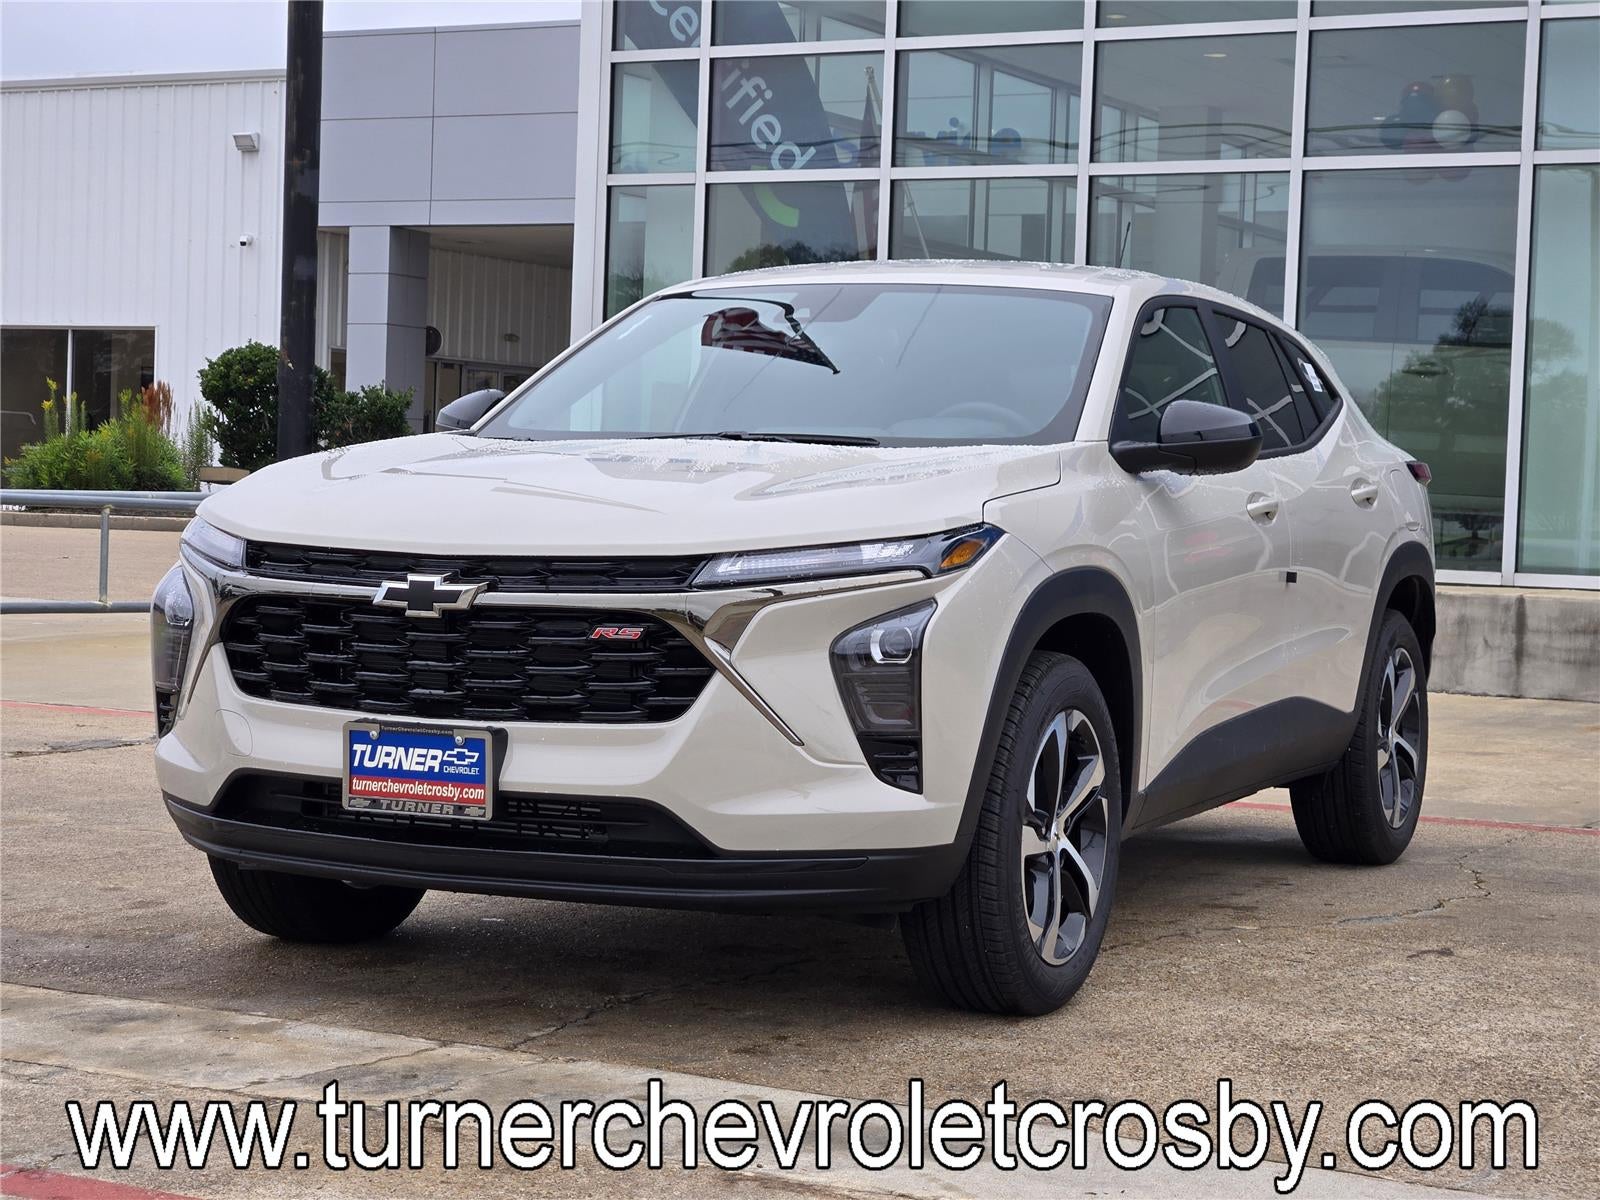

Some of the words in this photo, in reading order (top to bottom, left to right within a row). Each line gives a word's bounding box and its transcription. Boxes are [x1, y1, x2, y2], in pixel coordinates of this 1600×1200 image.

[591, 626, 645, 639] RS
[352, 743, 443, 772] TURNER
[443, 765, 479, 774] CHEVROLET
[352, 777, 484, 800] turnerchevroletcrosby.com
[380, 800, 454, 814] TURNER
